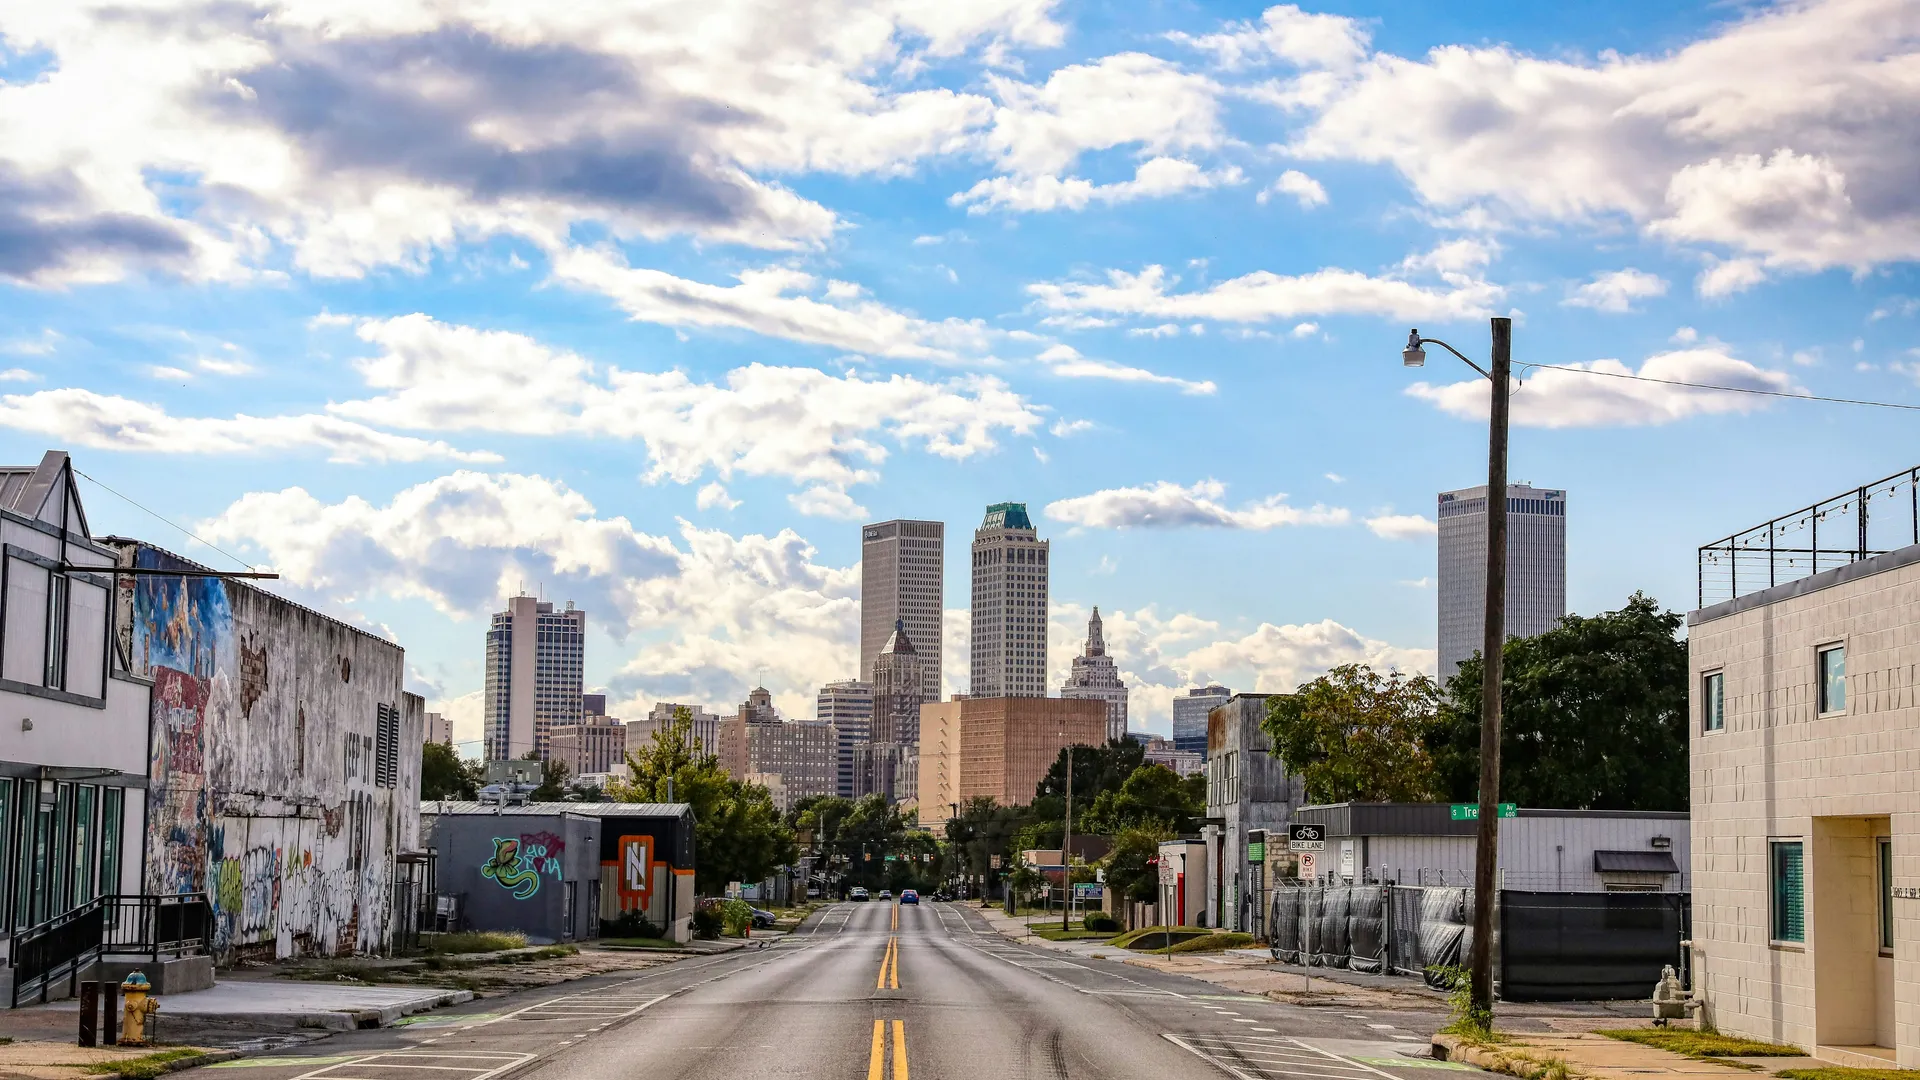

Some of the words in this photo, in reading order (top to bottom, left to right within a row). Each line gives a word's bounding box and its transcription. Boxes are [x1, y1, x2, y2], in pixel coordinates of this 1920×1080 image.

[344, 731, 360, 785] KEEP
[1463, 806, 1480, 818] Tre
[1292, 841, 1305, 849] BIKE
[1307, 841, 1323, 849] LANE
